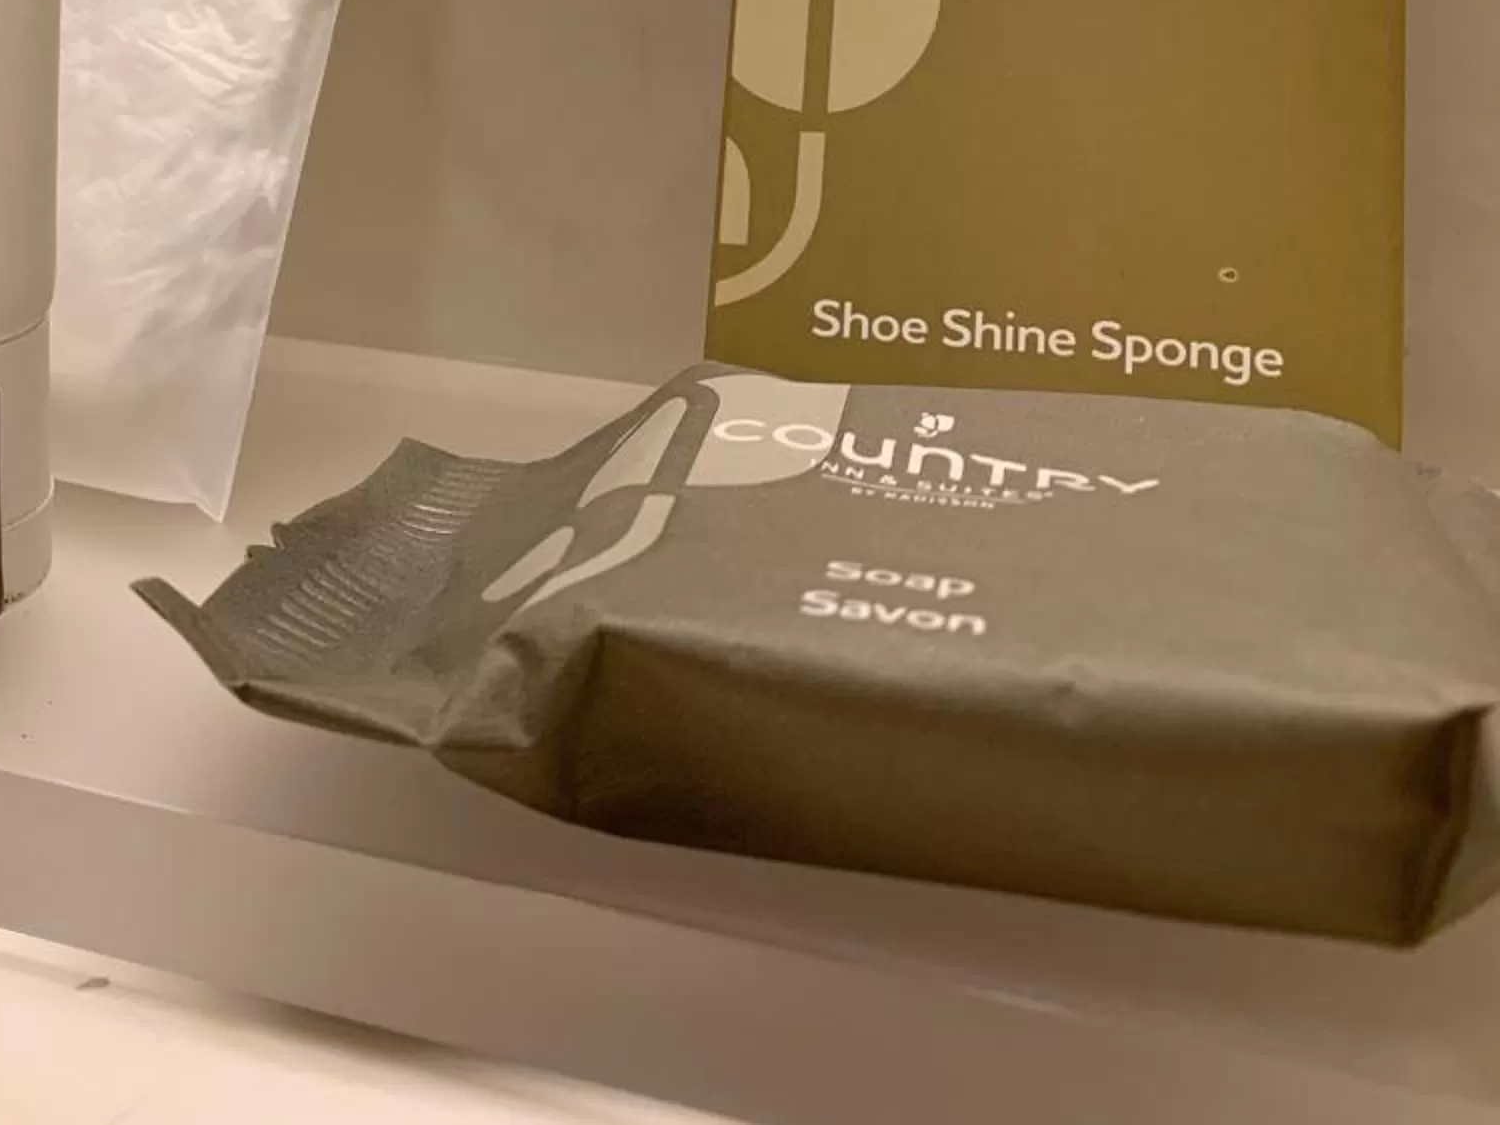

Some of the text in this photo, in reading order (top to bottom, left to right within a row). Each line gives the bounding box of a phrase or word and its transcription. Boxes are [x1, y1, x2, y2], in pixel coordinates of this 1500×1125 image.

[812, 299, 1285, 386] Shoe Shine Sponge
[825, 560, 976, 600] Soap
[800, 589, 987, 636] Savon
